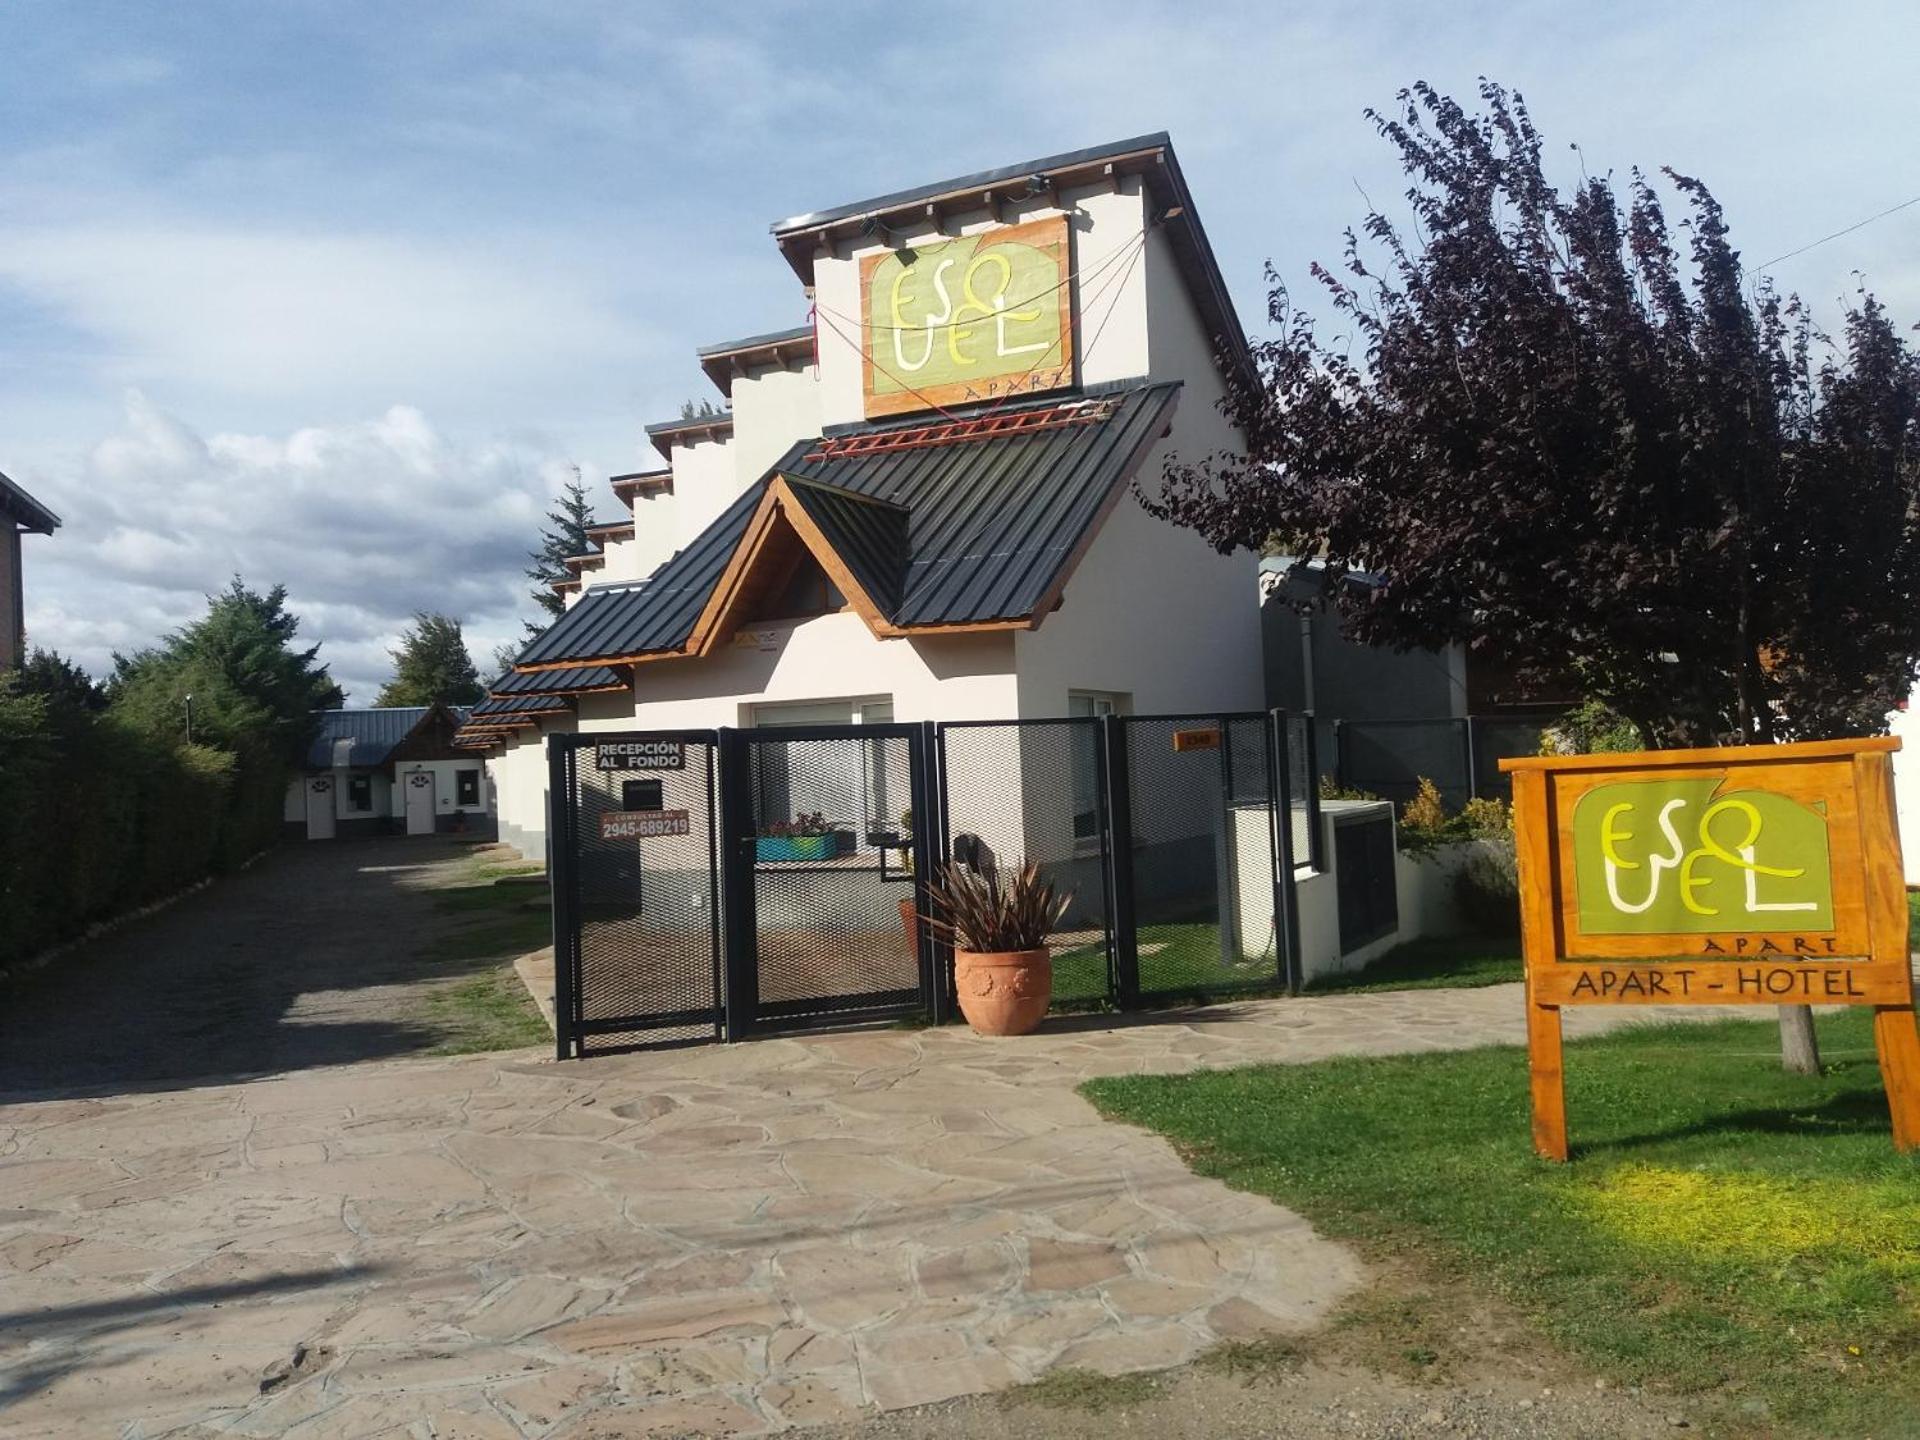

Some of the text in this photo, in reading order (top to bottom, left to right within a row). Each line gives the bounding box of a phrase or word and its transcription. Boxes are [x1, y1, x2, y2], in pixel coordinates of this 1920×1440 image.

[599, 741, 679, 755] RECEPCIÓN
[600, 756, 680, 768] AL FONDO
[602, 818, 688, 838] 2945-689219
[1704, 937, 1837, 954] APART
[1738, 968, 1865, 997] HOTEL
